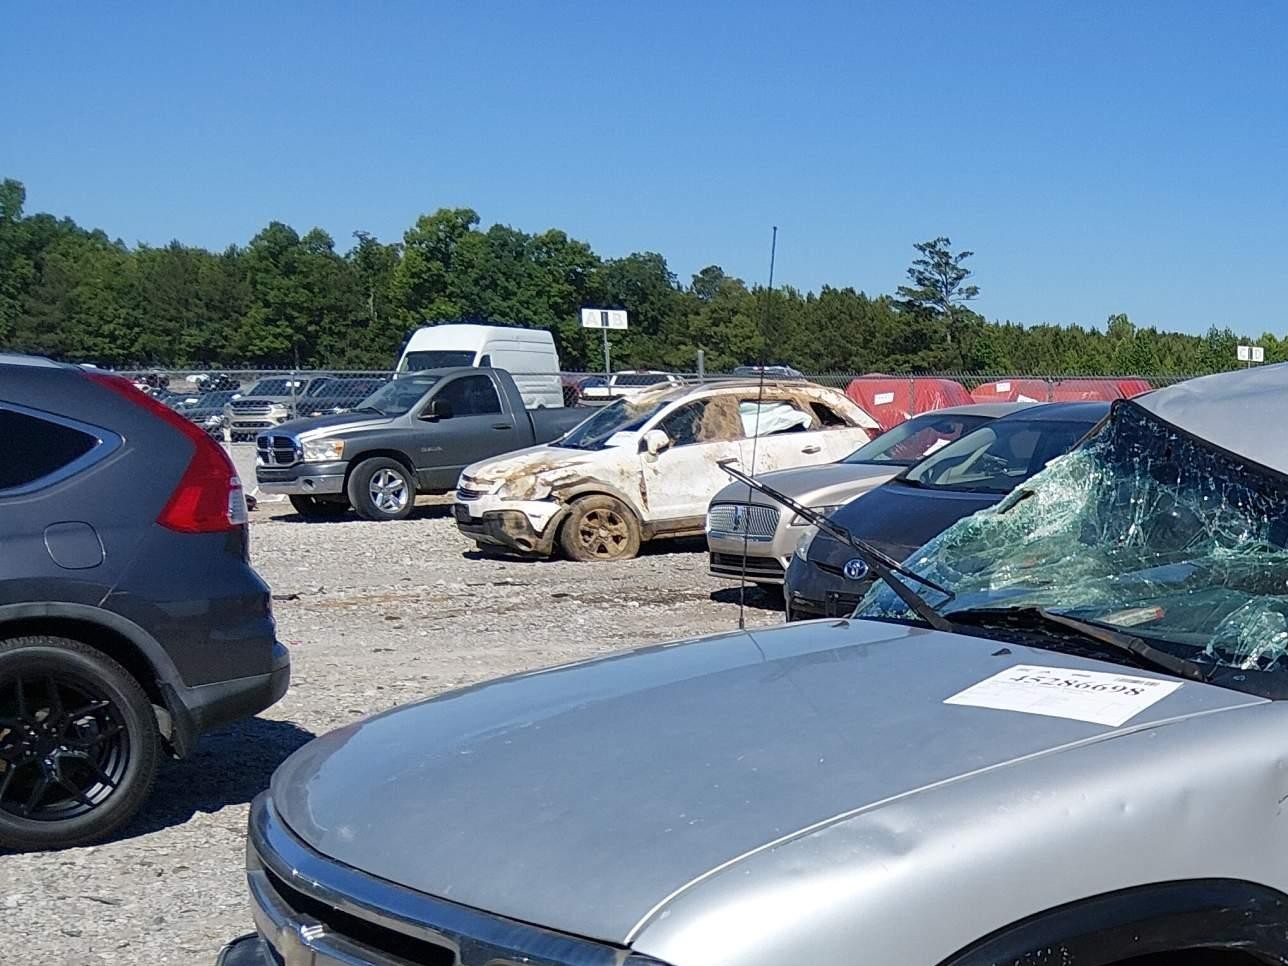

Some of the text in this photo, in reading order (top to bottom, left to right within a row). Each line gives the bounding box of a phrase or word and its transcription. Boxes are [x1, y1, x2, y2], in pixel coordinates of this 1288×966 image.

[585, 311, 625, 327] A B
[1239, 347, 1262, 360] C D
[1009, 675, 1145, 696] 45286698
